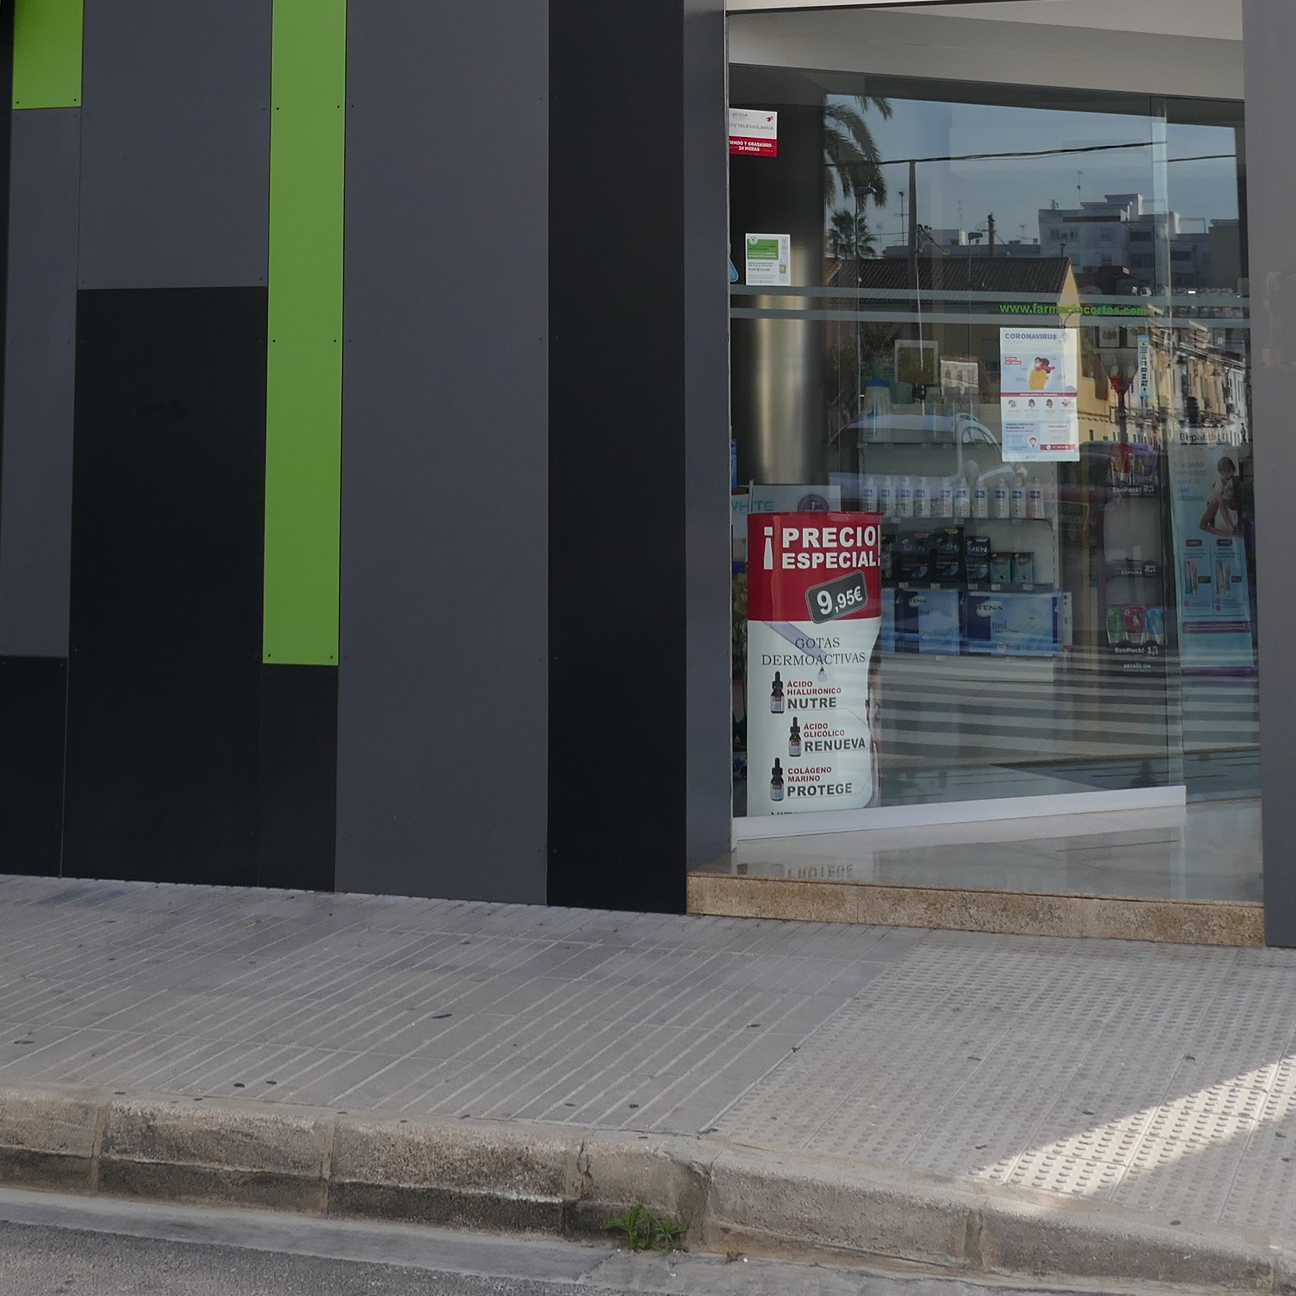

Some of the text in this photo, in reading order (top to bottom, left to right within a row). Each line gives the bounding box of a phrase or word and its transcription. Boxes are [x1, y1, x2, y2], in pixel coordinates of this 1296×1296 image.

[999, 303, 1147, 315] www.farmacortes.com
[1005, 332, 1057, 340] CORONAVIRUS
[782, 526, 877, 548] PRECIO
[816, 585, 863, 615] 9,95€
[992, 621, 1007, 630] Bed
[795, 637, 840, 650] GOTAS
[761, 652, 866, 666] DERMOACTIVAS
[787, 680, 813, 688] ÁCIDO
[787, 687, 841, 696] HIALURÓNICO
[787, 697, 837, 709] NUTRE
[803, 722, 828, 730] ÁCIDO
[803, 730, 845, 738] GLICÓLICO
[804, 738, 866, 752] RENUEVA
[787, 766, 832, 775] COLÁGENO
[787, 783, 853, 797] PROTEGE
